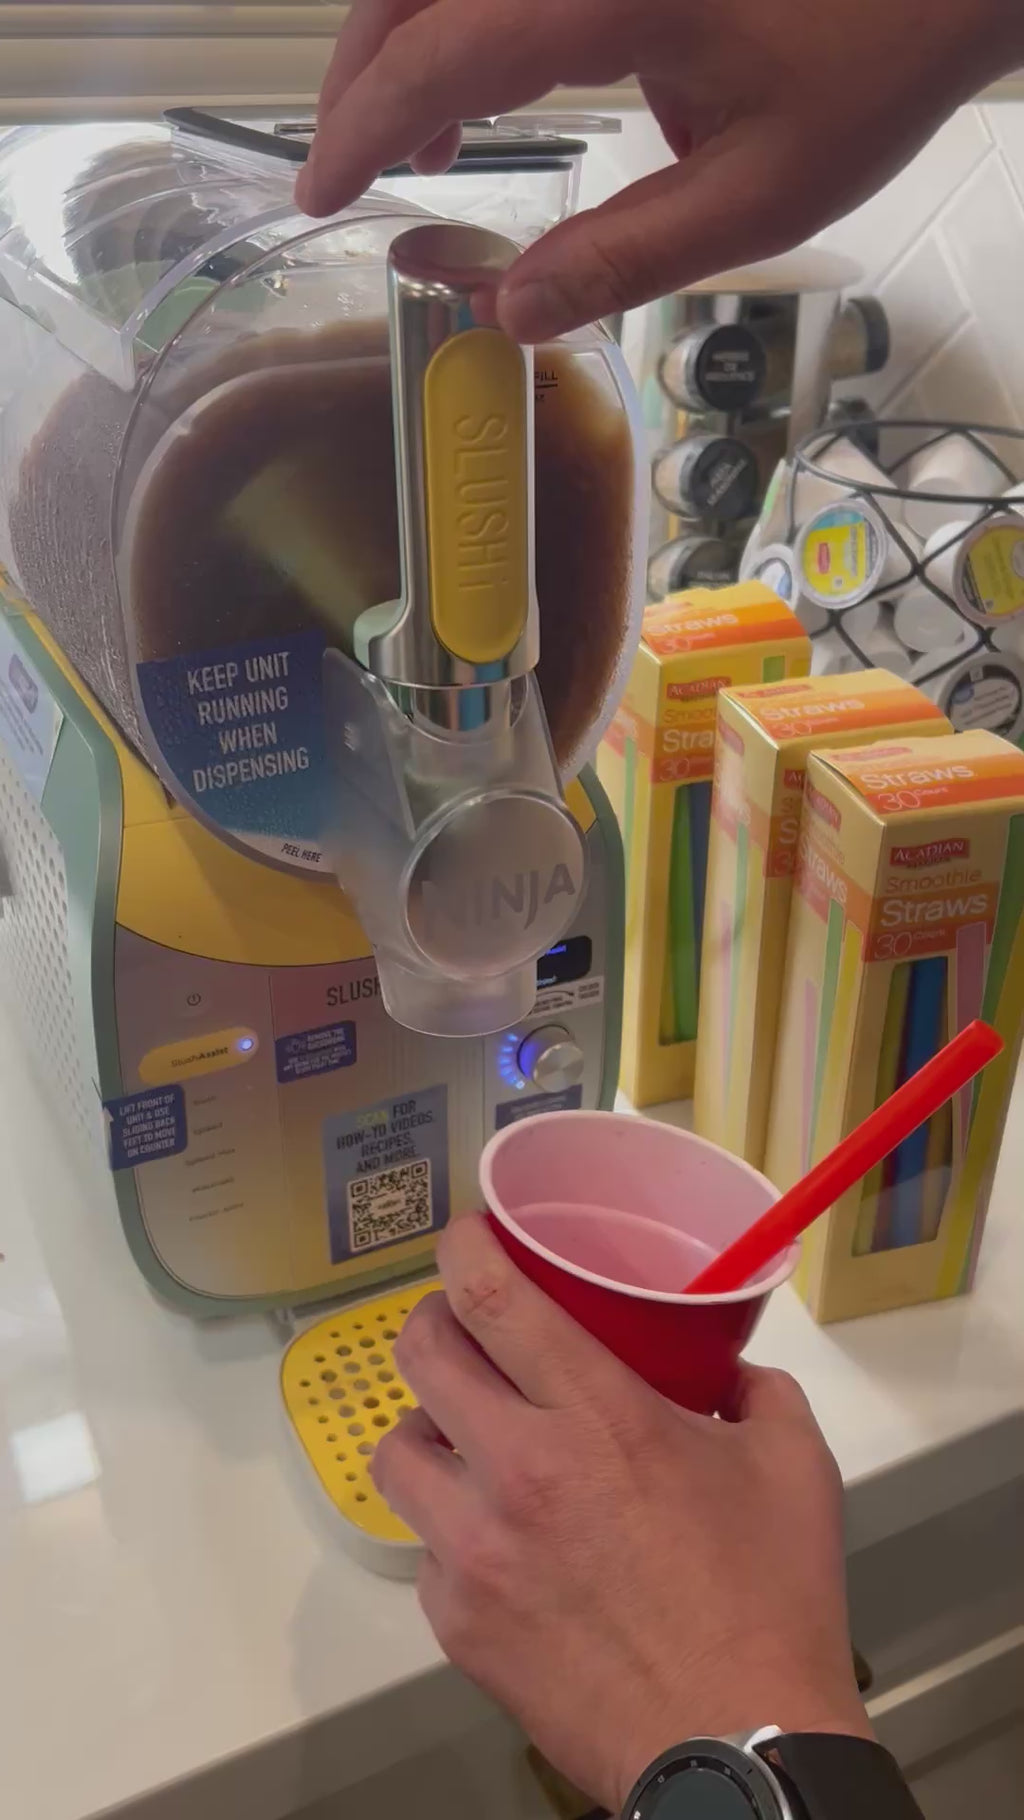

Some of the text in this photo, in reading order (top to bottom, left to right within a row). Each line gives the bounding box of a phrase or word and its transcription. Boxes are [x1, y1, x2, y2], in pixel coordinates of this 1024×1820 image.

[187, 652, 291, 695] KEEP UNIT
[197, 686, 289, 726] RUNNING
[760, 699, 865, 721] Straws
[218, 722, 278, 755] WHEN
[193, 747, 310, 793] DISPENSING
[860, 765, 975, 790] Straws
[878, 791, 920, 811] 30
[281, 843, 323, 863] PEEL HERE
[894, 840, 964, 862] ACADIAN
[887, 868, 982, 893] Smoothie
[421, 863, 577, 942] NINJA
[880, 893, 988, 927] Straws
[873, 931, 912, 960] 30
[137, 1096, 164, 1111] FRONT
[164, 1093, 175, 1105] OF
[392, 1100, 417, 1118] FOR
[122, 1116, 176, 1137] SLIDING BACK
[126, 1112, 144, 1125] UNIT
[154, 1127, 176, 1140] MOVE
[127, 1138, 175, 1158] ON COUNTER
[356, 1156, 381, 1173] AND
